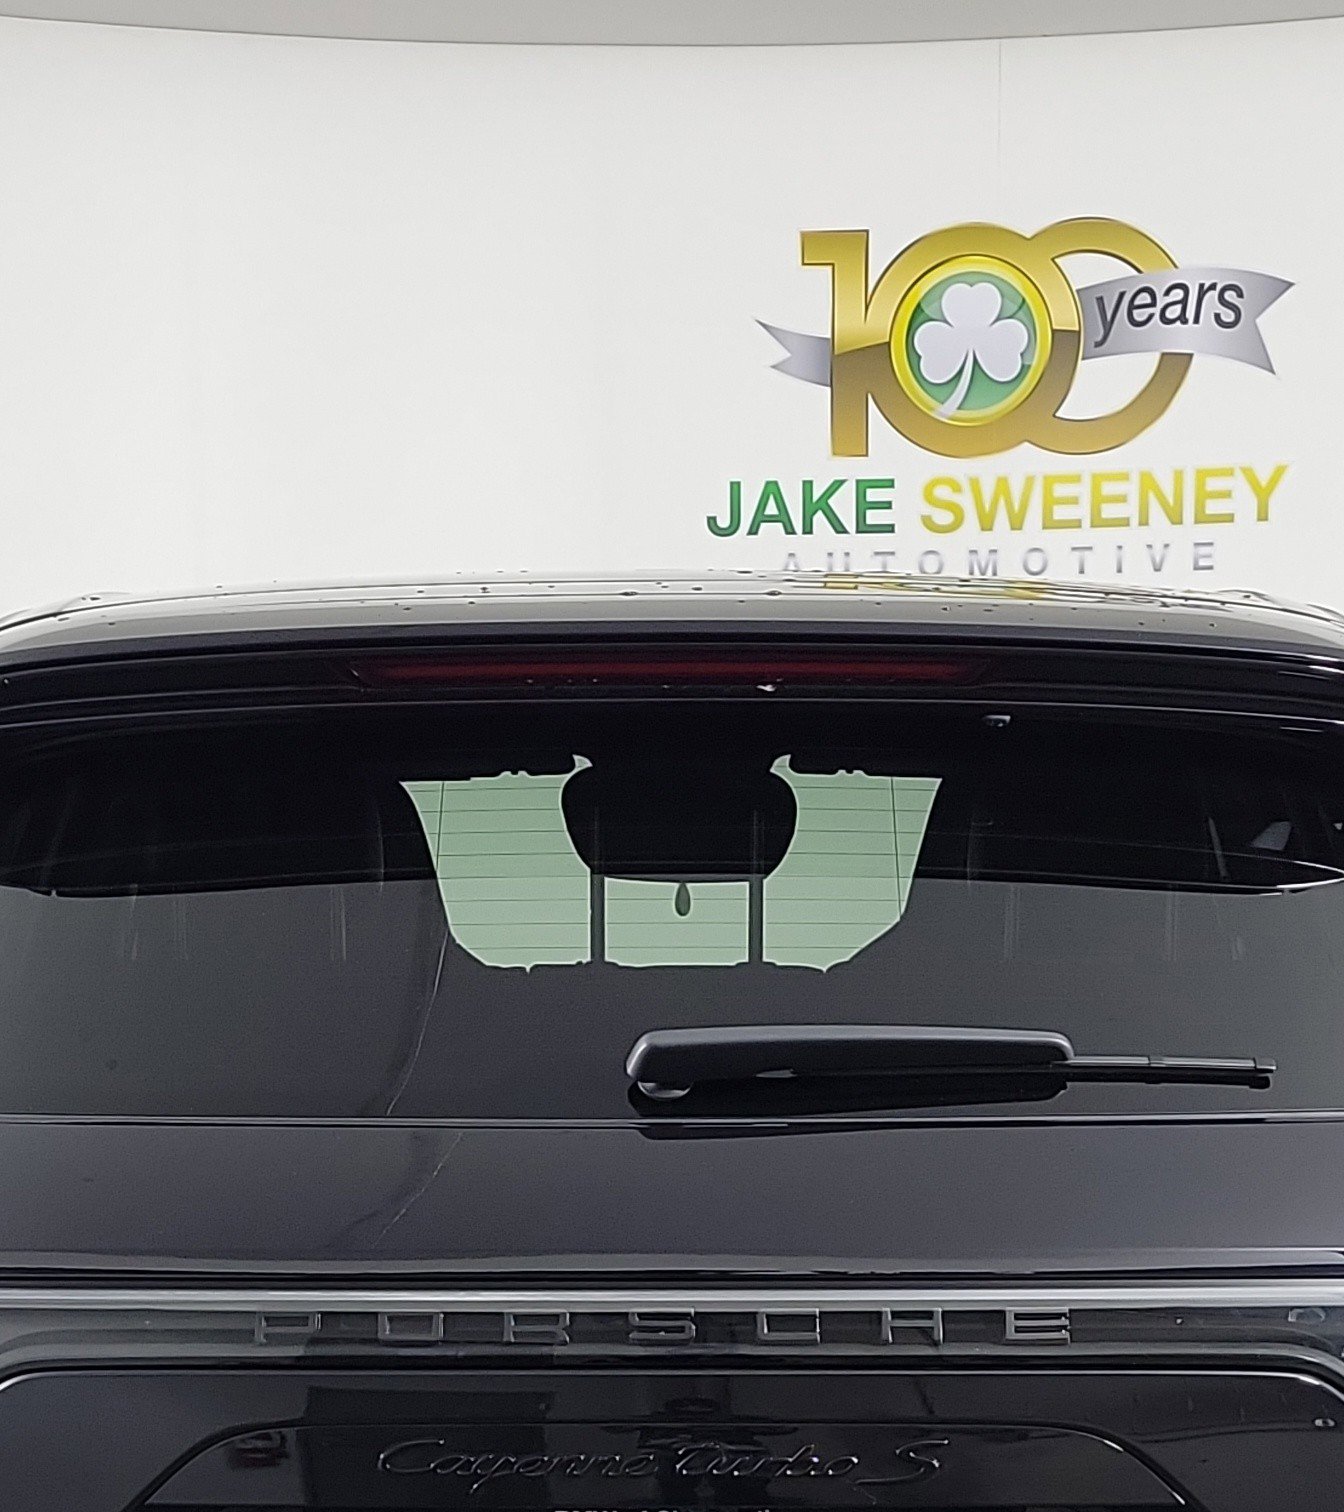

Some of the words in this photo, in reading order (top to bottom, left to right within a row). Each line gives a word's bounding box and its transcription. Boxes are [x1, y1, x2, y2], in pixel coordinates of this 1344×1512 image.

[800, 216, 1194, 458] 100
[1094, 279, 1245, 347] years
[706, 477, 896, 537] JAKE
[920, 464, 1289, 534] SWEENEY
[256, 1307, 1070, 1346] PORSCHE
[377, 1438, 659, 1495] Cayenne
